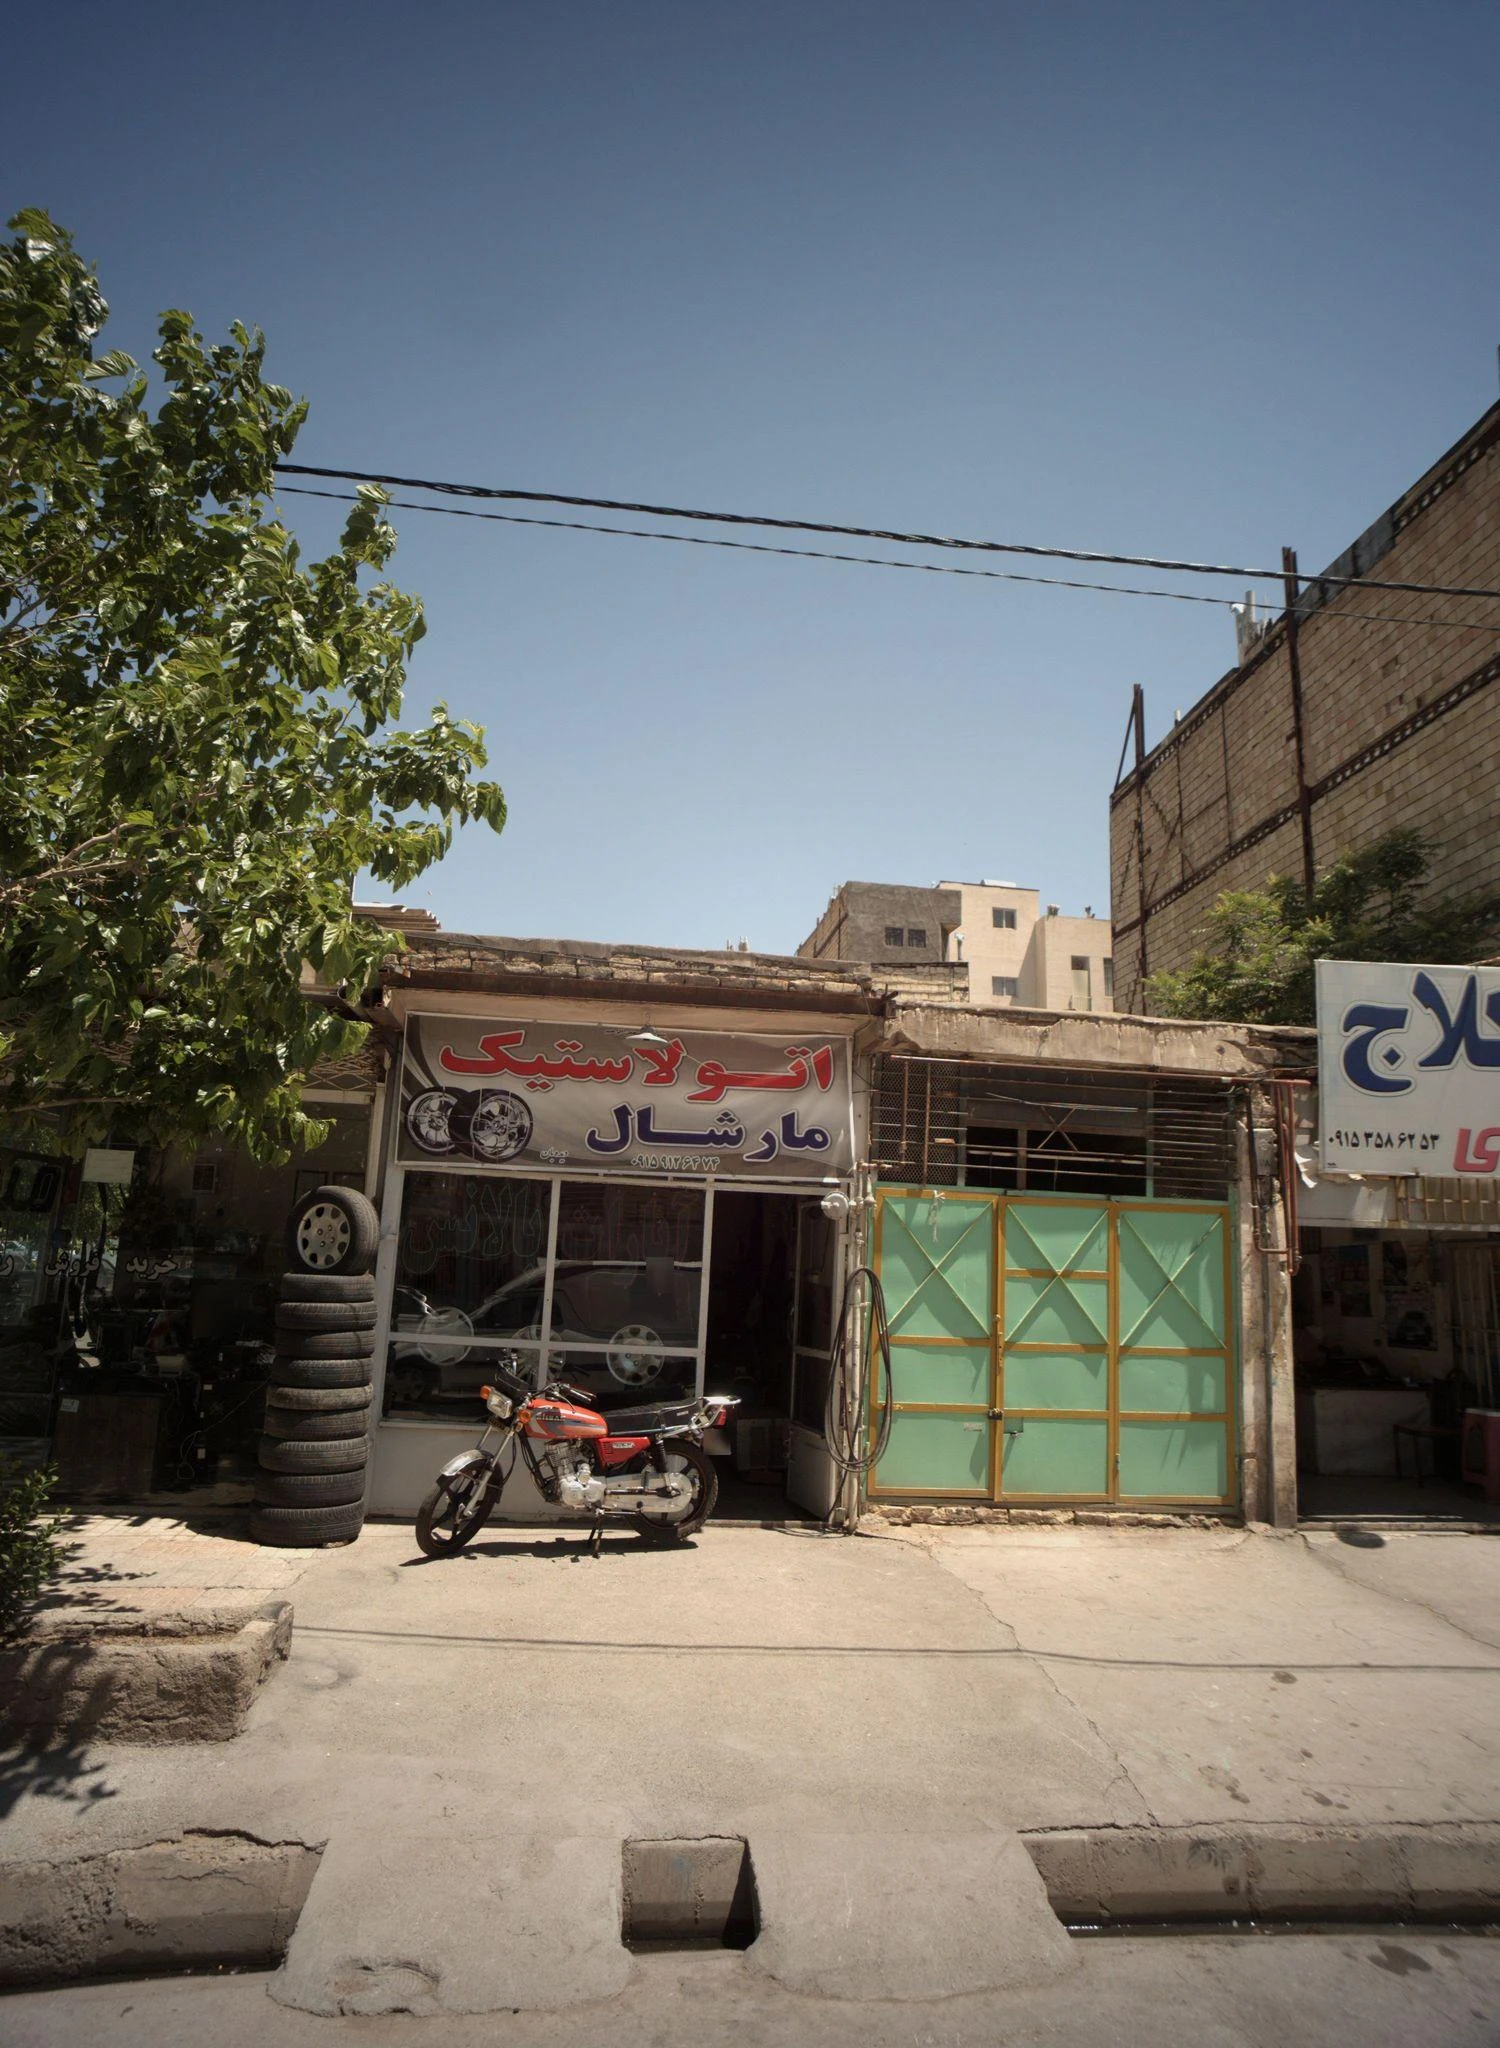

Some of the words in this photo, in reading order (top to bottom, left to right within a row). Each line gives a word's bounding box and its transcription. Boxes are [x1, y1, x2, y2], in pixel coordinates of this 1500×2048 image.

[1342, 970, 1500, 1094] لاج
[584, 1102, 831, 1163] مارشال
[44, 1251, 101, 1278] فروش
[125, 1254, 178, 1281] خرید
